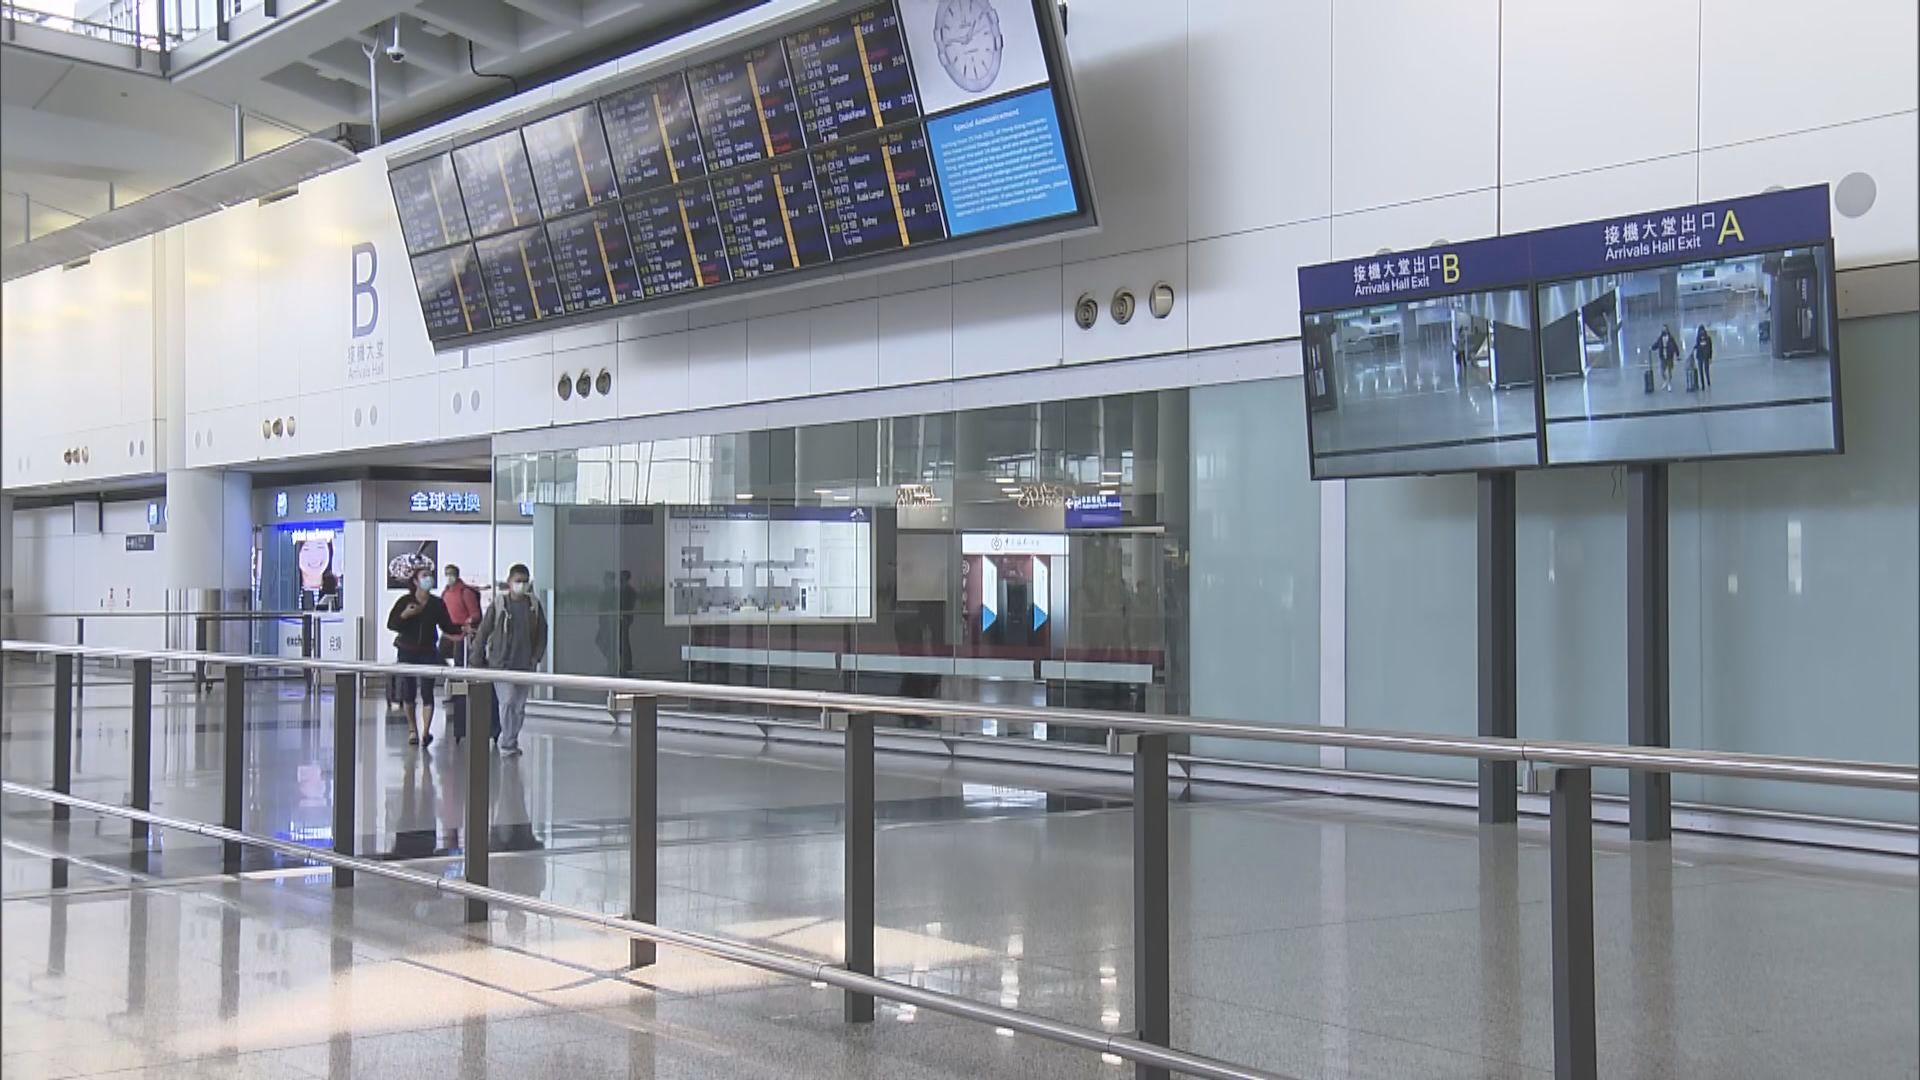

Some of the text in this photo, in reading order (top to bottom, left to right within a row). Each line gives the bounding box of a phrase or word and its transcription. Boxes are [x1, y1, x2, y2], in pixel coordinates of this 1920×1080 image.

[1604, 212, 1715, 246] 接機大堂出口
[1717, 209, 1745, 245] A
[1605, 234, 1702, 261] Arrivals Hall Exit
[1354, 254, 1441, 284] 接機大堂出口
[1442, 253, 1461, 284] B
[351, 241, 379, 339] B
[1354, 274, 1430, 297] Arrivals Hall Exit
[411, 491, 480, 512] 全球兌換
